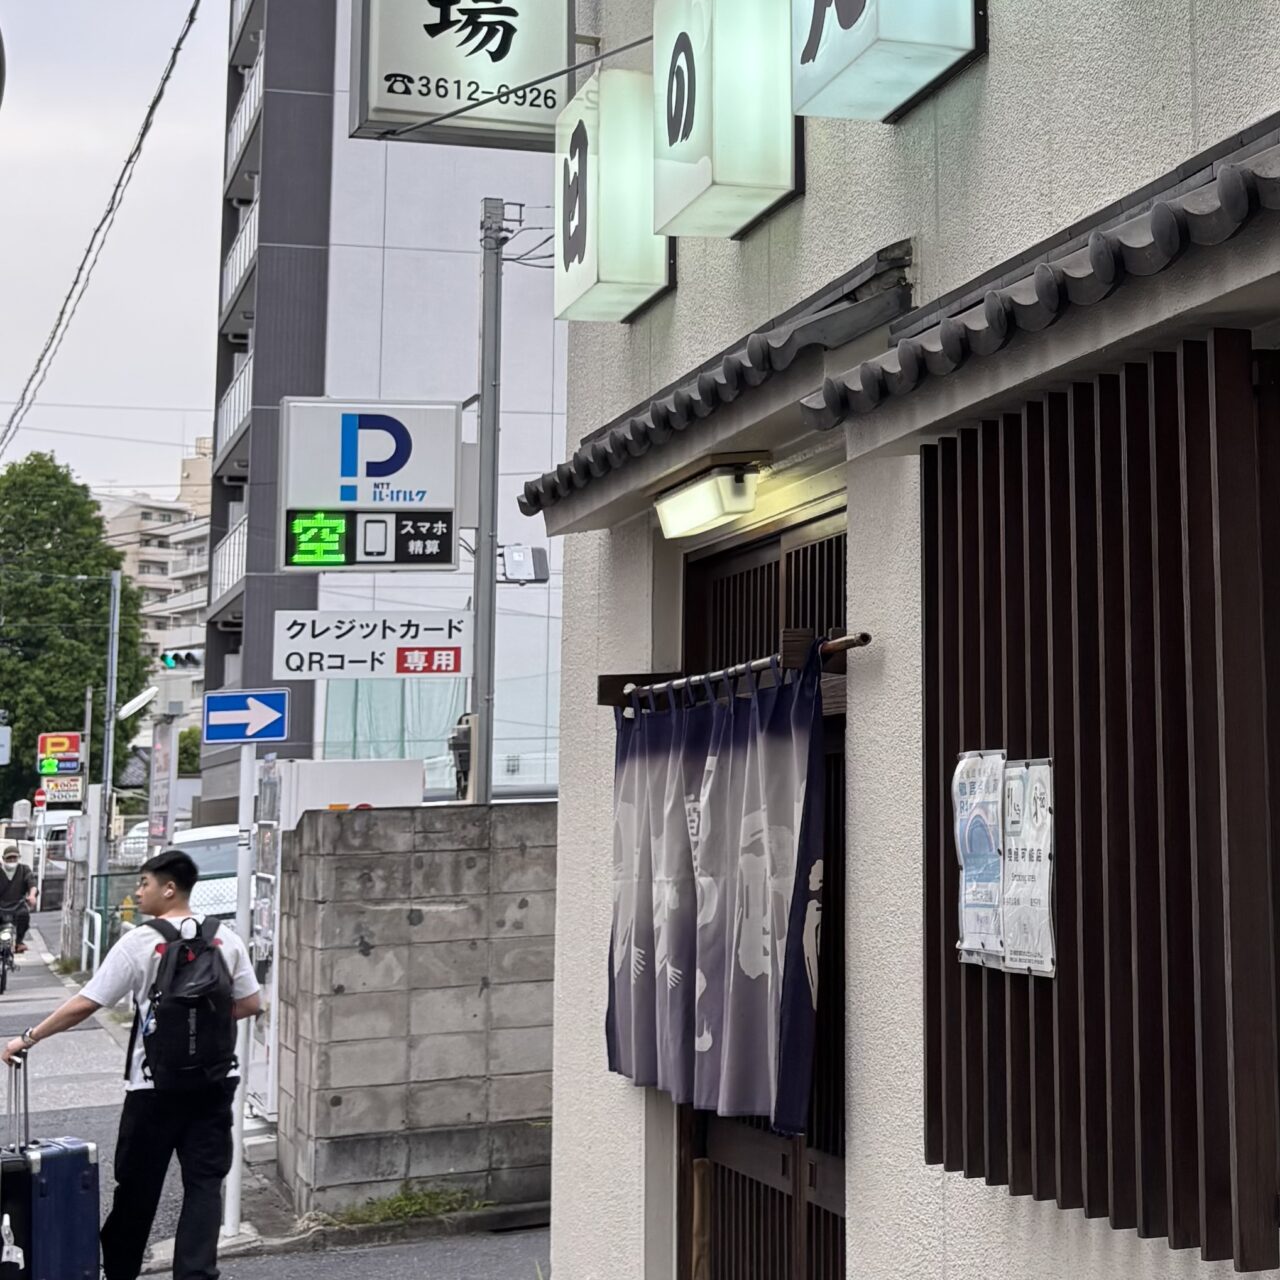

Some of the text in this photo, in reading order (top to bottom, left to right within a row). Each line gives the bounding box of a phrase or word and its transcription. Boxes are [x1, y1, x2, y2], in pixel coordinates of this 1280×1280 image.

[563, 119, 588, 272] 日
[667, 31, 696, 147] の
[373, 482, 391, 490] NTT
[292, 512, 345, 562] 空
[400, 520, 448, 535] スマホ
[408, 539, 440, 555] 精算
[286, 618, 464, 640] クレジットカード
[285, 649, 455, 673] QRコード 専用
